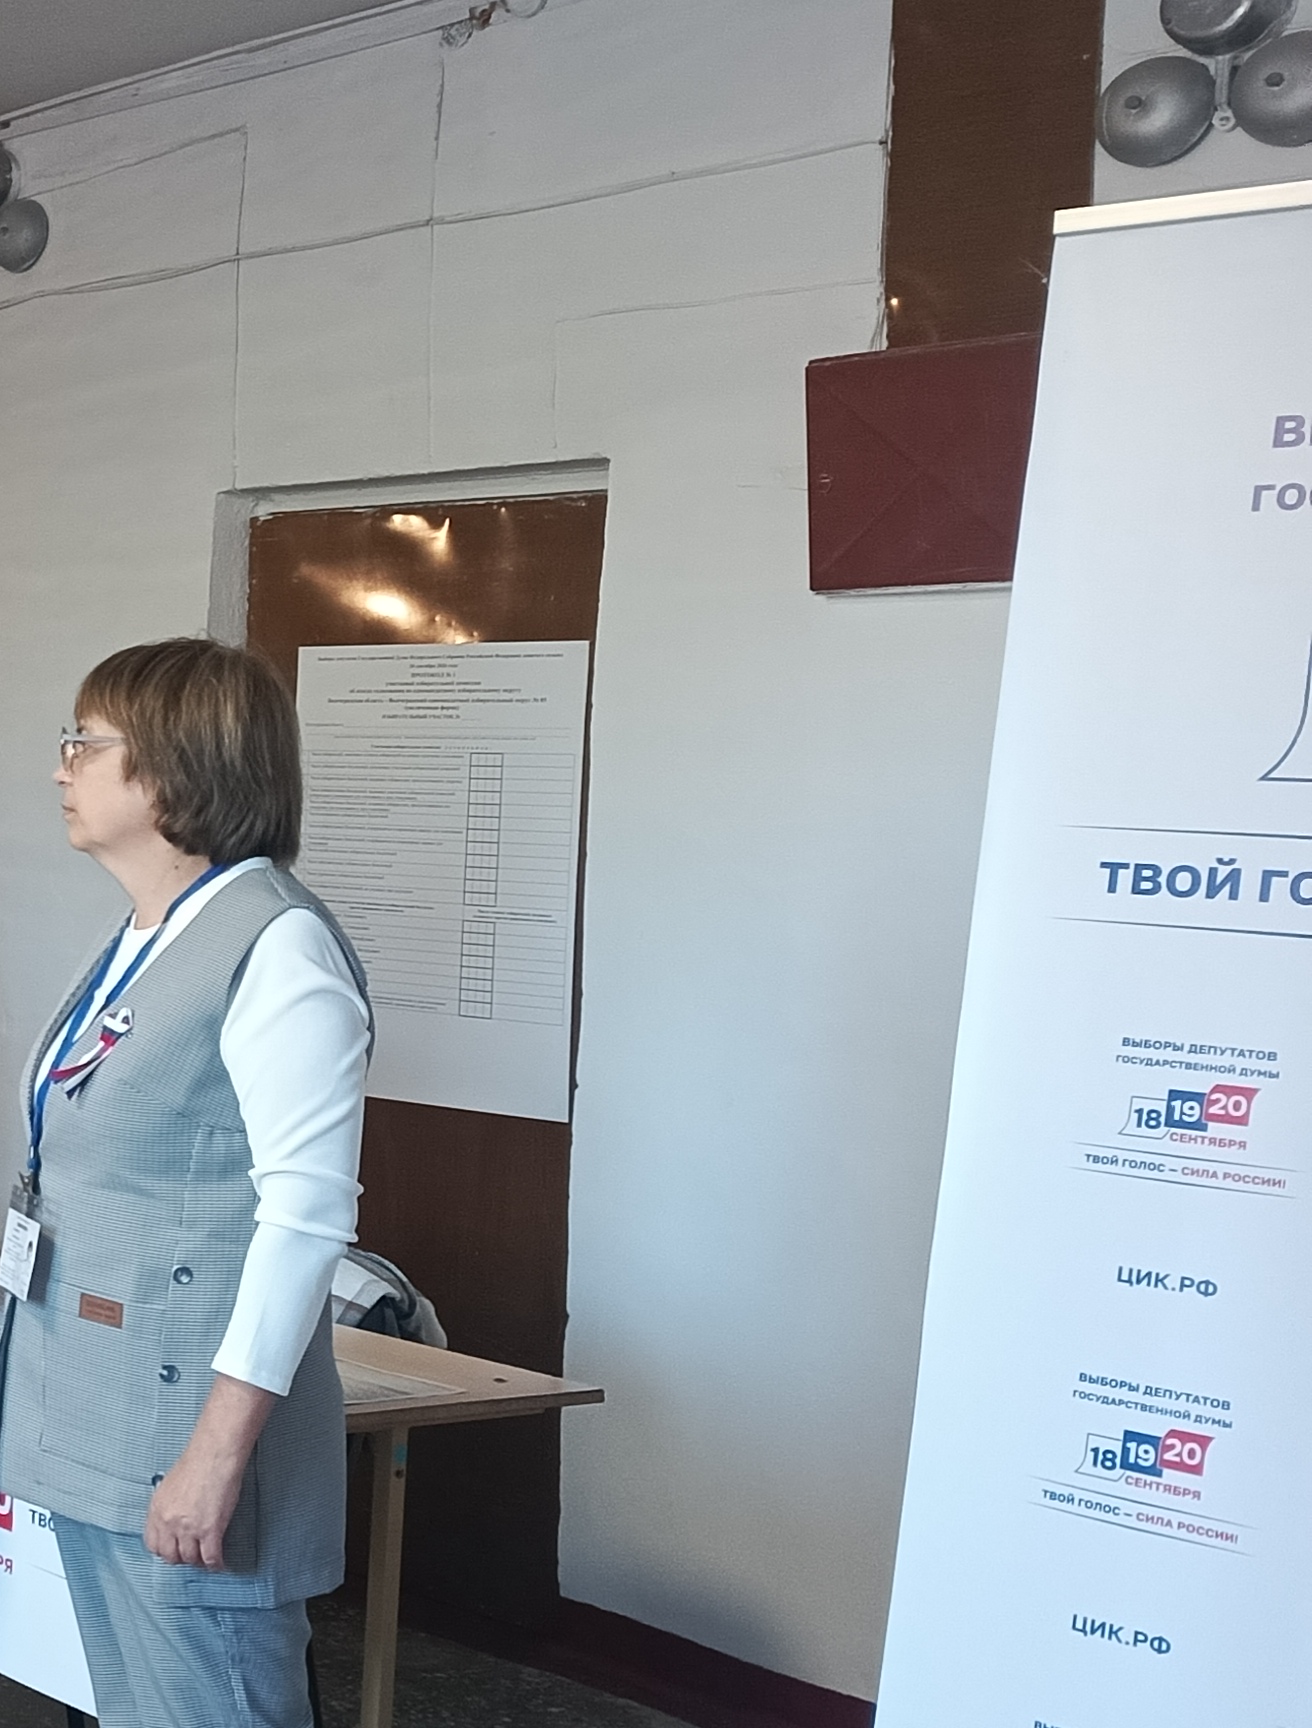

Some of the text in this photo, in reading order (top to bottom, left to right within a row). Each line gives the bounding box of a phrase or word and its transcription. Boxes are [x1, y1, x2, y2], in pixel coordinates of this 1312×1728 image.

[1099, 857, 1242, 901] ТВОЙ
[1122, 1037, 1278, 1062] ВЫБОРЫ ДЕПУТАТОВ
[1116, 1054, 1280, 1080] ГОСУДАРСТВЕННОЙ ДУМЫ
[1133, 1092, 1248, 1130] 18 19 20
[1169, 1132, 1247, 1151] СЕНТЯБРЯ
[1084, 1153, 1119, 1167] ТВОЙ
[1122, 1158, 1166, 1173] ГОЛОС
[1181, 1166, 1219, 1180] СИЛА
[1223, 1172, 1286, 1189] РОССИИ!
[1116, 1265, 1218, 1297] ЦИК.РФ
[1079, 1372, 1231, 1411] ВЫБОРЫ ДЕПУТАТОВ
[1073, 1389, 1233, 1429] ГОСУДАРСТВЕННОЙ ДУМЫ
[1090, 1438, 1202, 1471] 18 19 20
[1125, 1475, 1202, 1501] СЕНТЯБРЯ
[28, 1509, 55, 1532] ТВО
[1041, 1489, 1075, 1505] ТВОЙ
[1078, 1498, 1121, 1516] ГОЛОС
[1136, 1512, 1174, 1529] СИЛА
[1177, 1521, 1239, 1545] РОССИИ!
[1071, 1613, 1172, 1654] ЦИК.РФ
